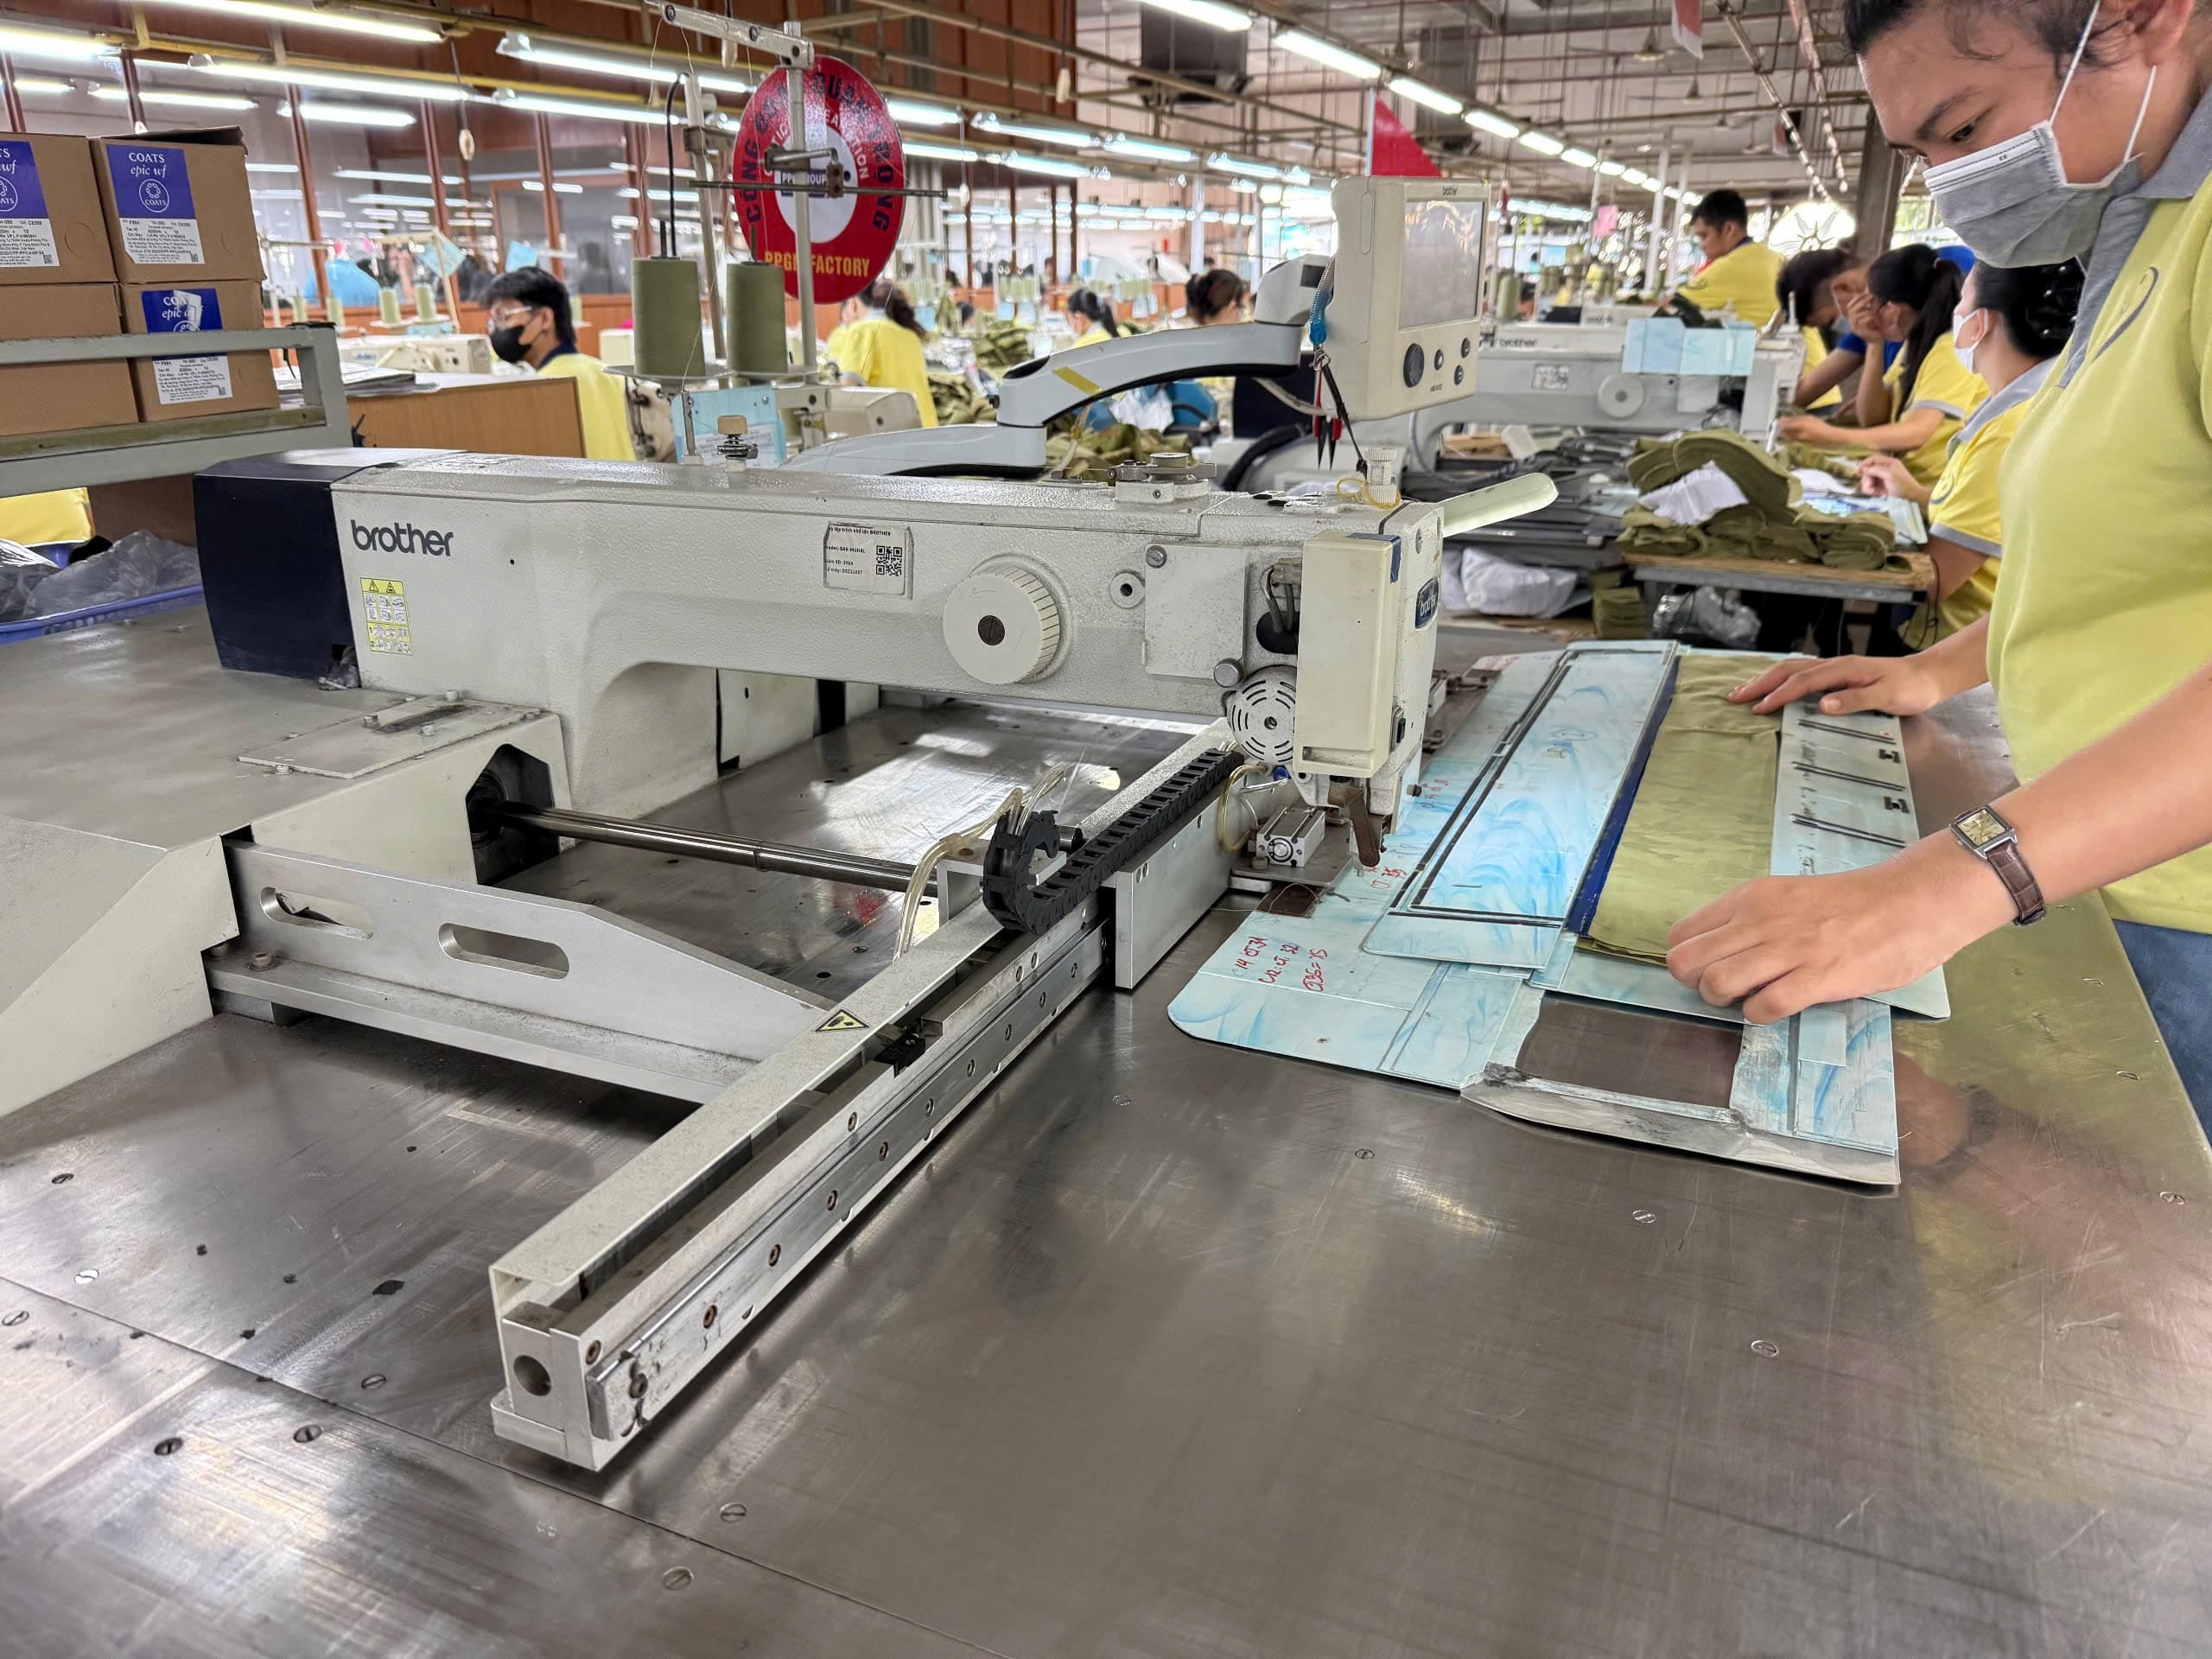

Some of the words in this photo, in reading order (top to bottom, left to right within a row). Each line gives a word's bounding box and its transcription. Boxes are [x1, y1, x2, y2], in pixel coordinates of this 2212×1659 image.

[129, 152, 165, 163] COATS
[130, 164, 151, 177] epic
[154, 164, 167, 178] wf
[162, 308, 182, 321] epic
[351, 519, 454, 556] brother
